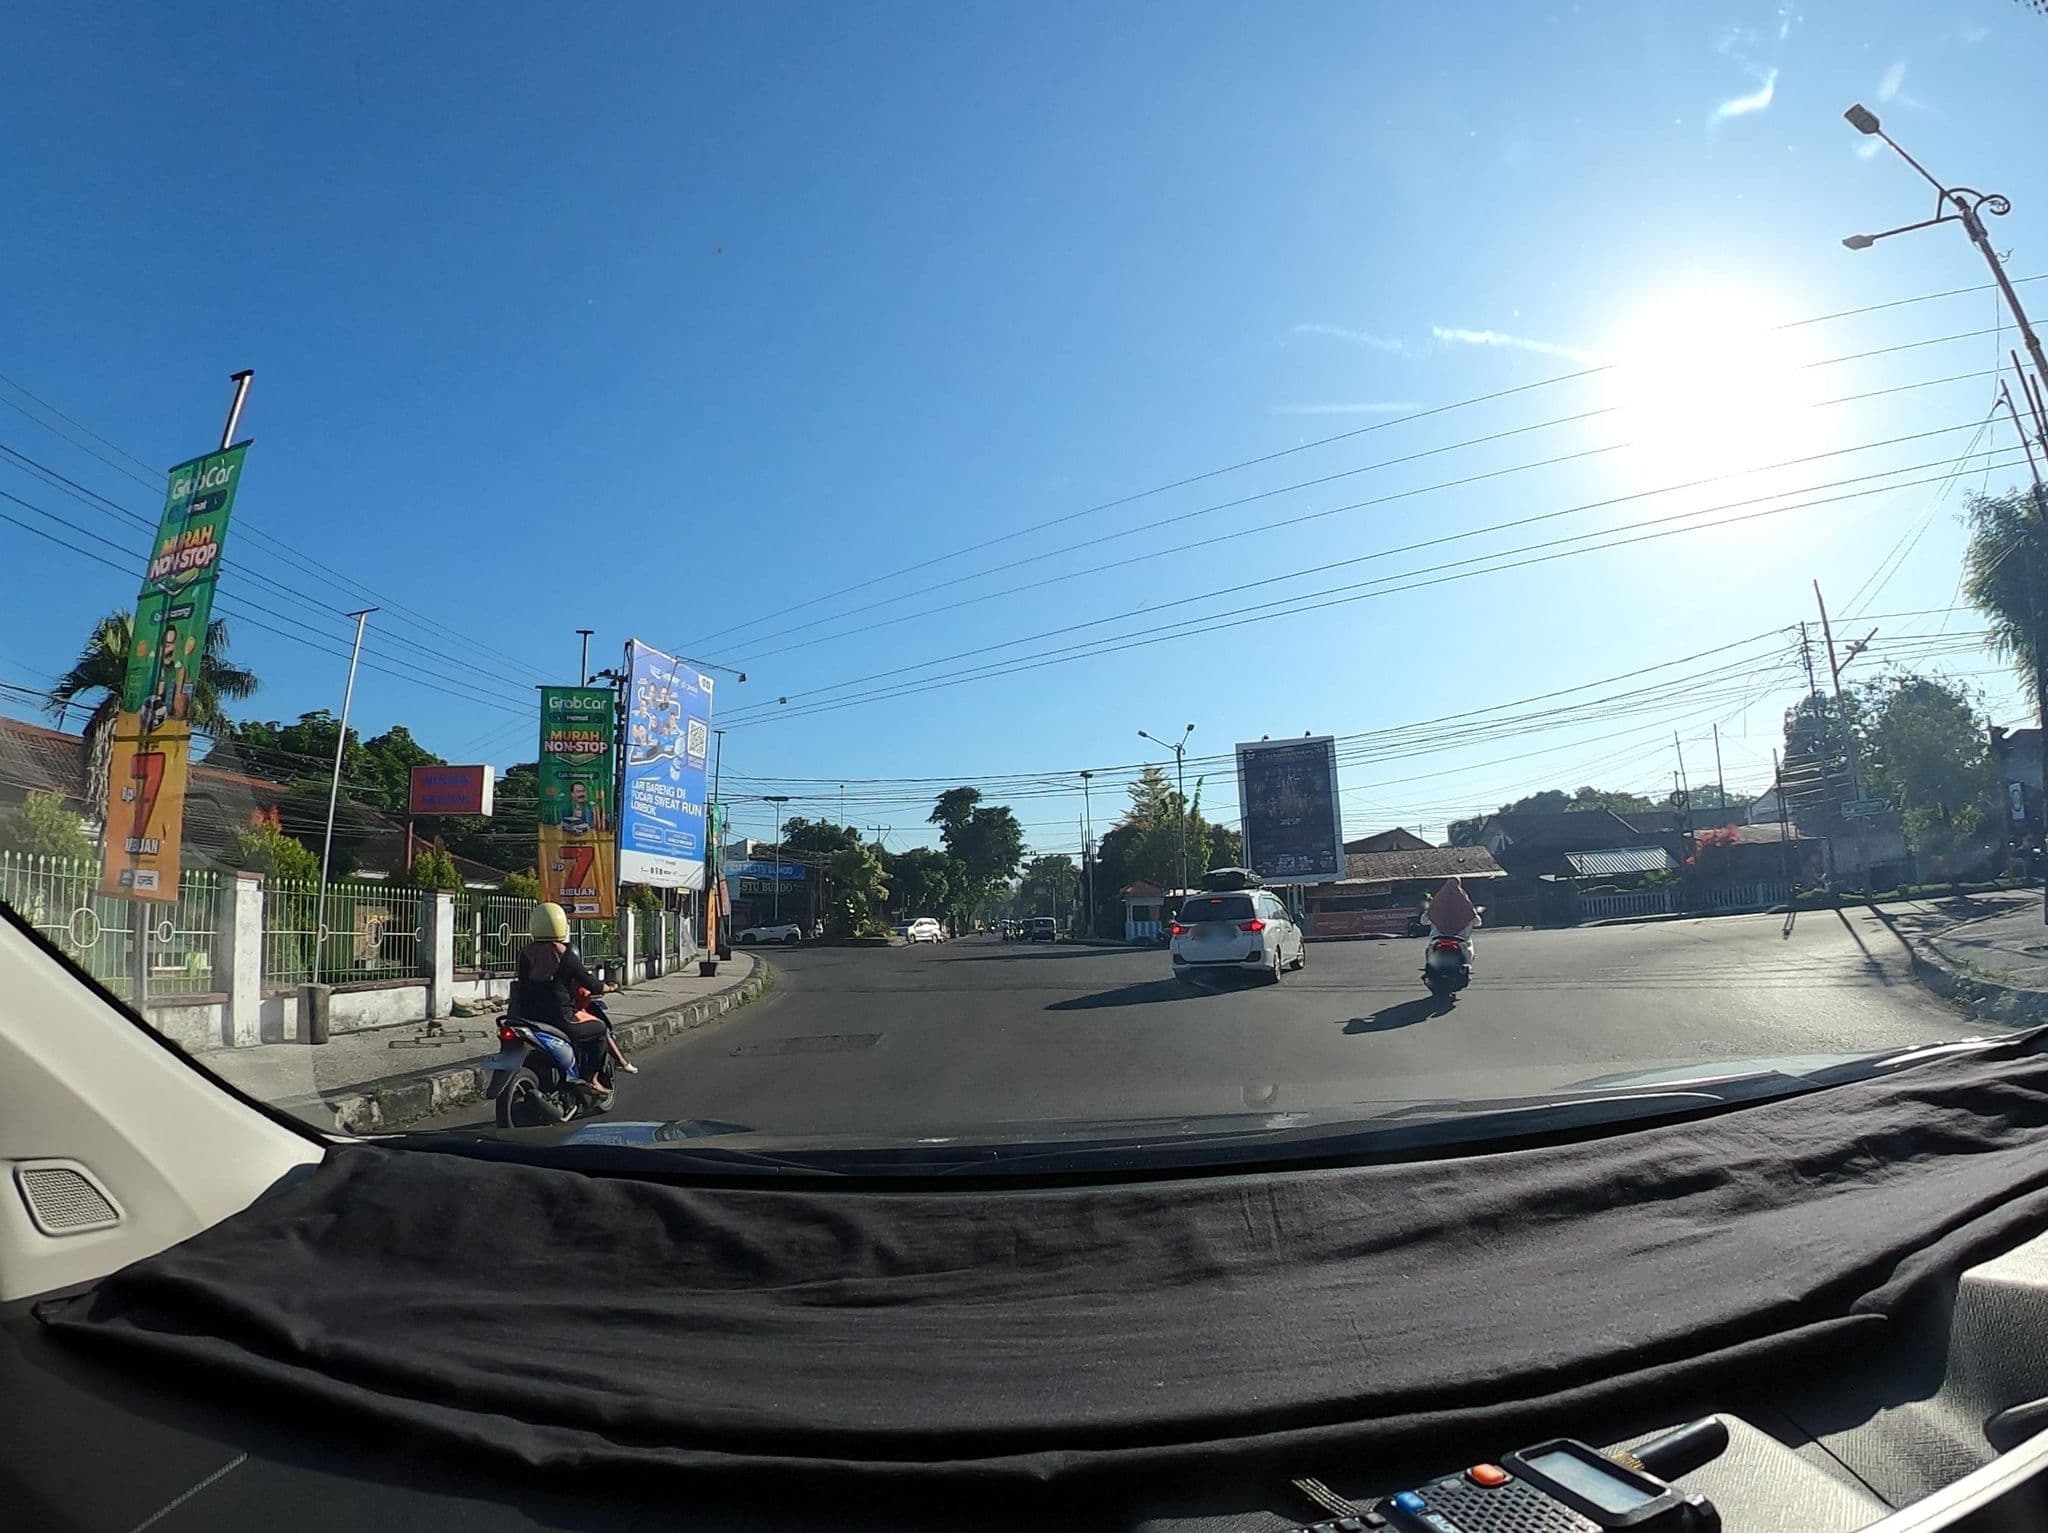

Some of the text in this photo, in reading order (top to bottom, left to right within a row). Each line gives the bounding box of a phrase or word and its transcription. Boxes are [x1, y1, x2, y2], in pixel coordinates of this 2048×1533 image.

[549, 696, 607, 710] GrabCar
[550, 730, 600, 741] MURAH
[544, 740, 609, 754] NON-STOP
[677, 787, 686, 800] DI
[654, 795, 680, 811] SWEAT
[682, 802, 702, 817] RUN
[560, 847, 595, 888] 7
